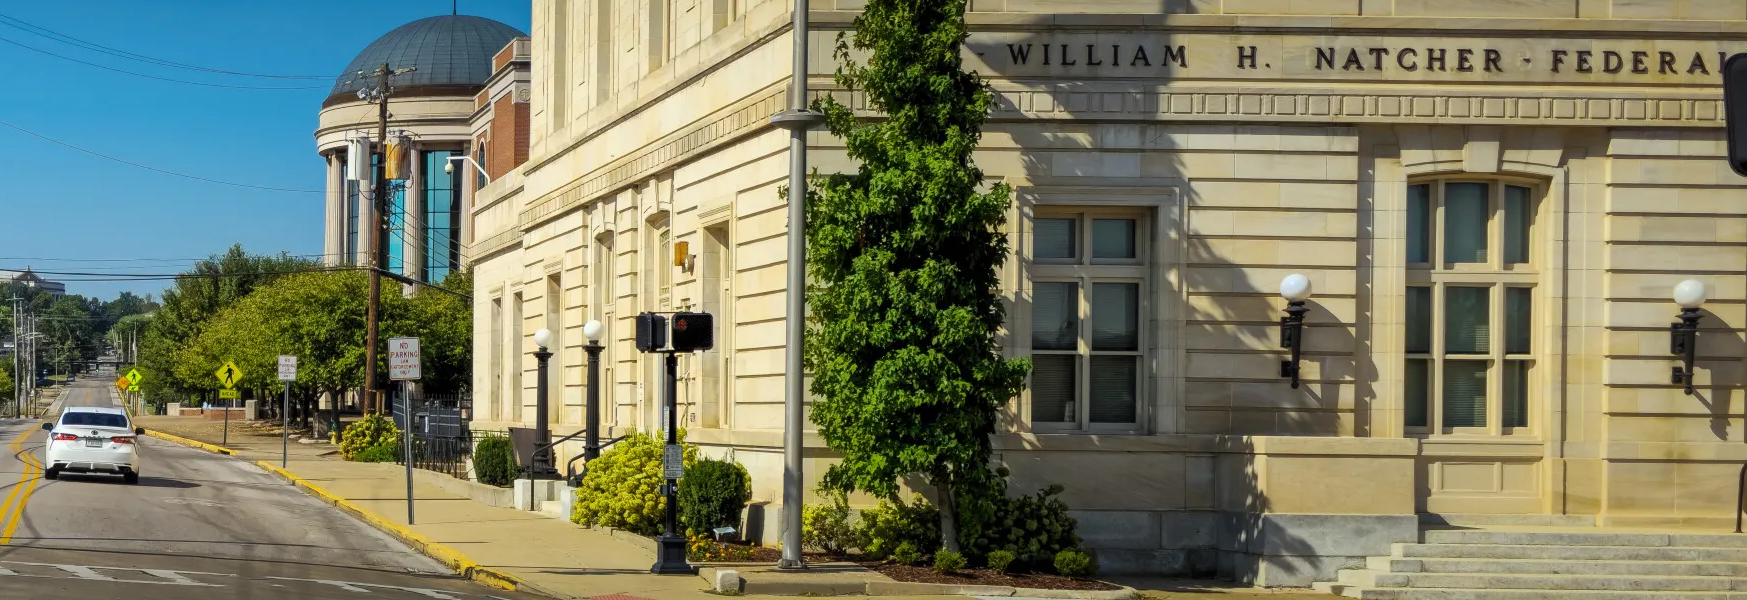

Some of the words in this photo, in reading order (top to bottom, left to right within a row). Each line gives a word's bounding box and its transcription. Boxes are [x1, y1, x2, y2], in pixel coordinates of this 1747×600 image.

[1007, 43, 1188, 68] WILLIAM
[1236, 45, 1271, 70] H.
[1314, 47, 1503, 73] NATCHER
[399, 342, 409, 350] NO
[390, 350, 418, 359] PARKING
